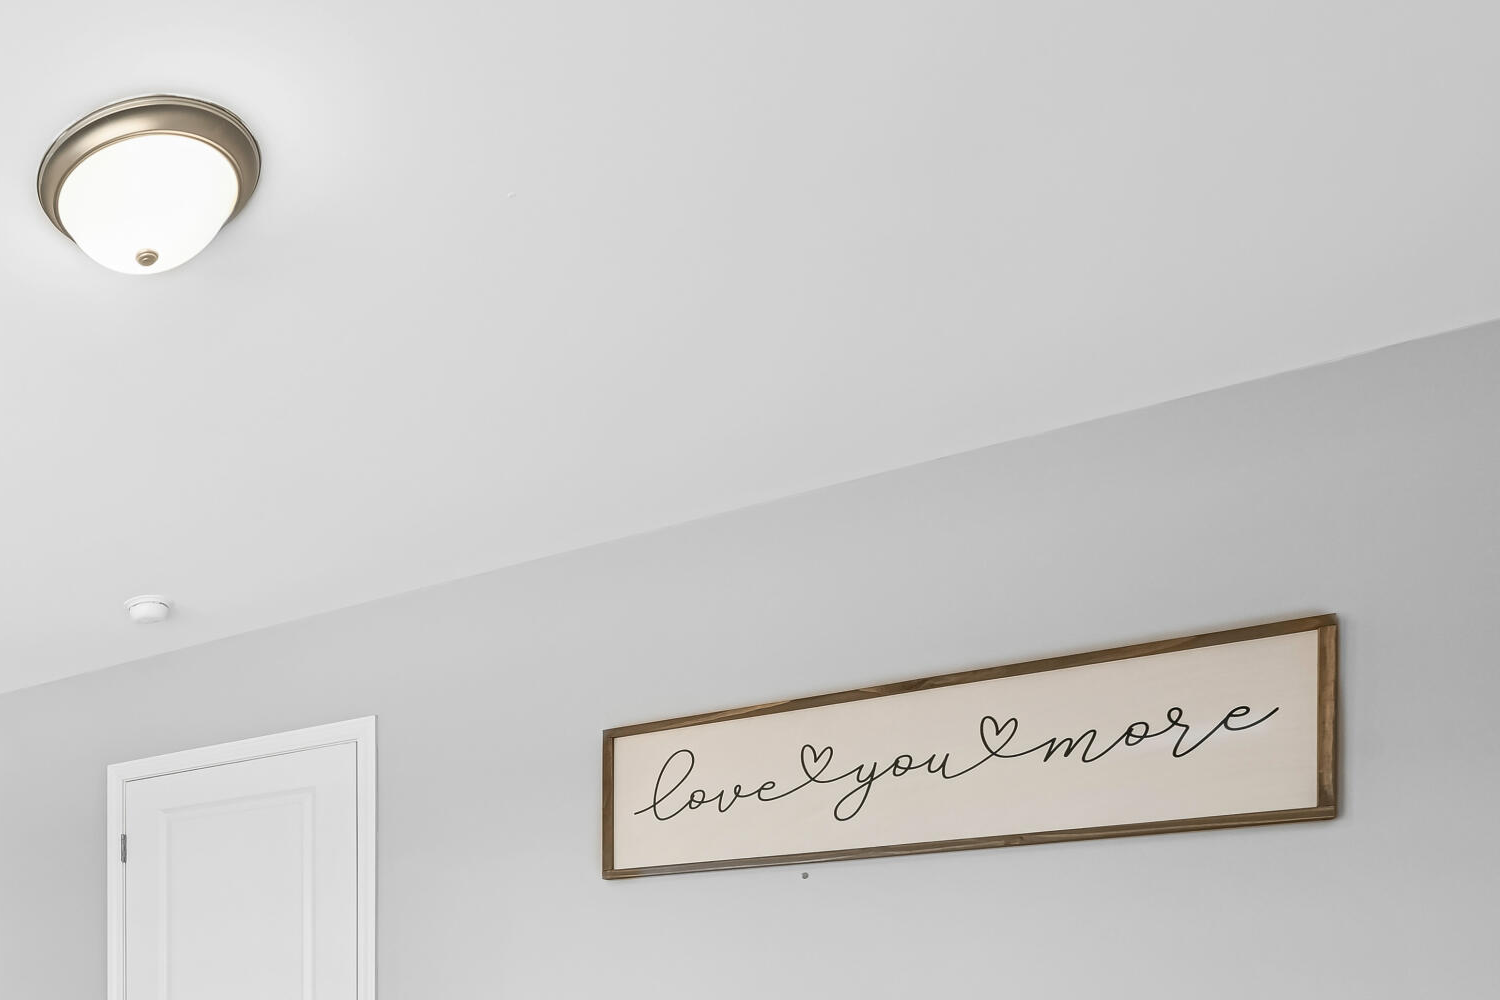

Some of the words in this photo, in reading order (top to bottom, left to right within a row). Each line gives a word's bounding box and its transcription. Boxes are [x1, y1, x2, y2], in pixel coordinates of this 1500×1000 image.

[634, 749, 800, 821] love
[833, 753, 968, 821] you
[1036, 705, 1279, 763] more
